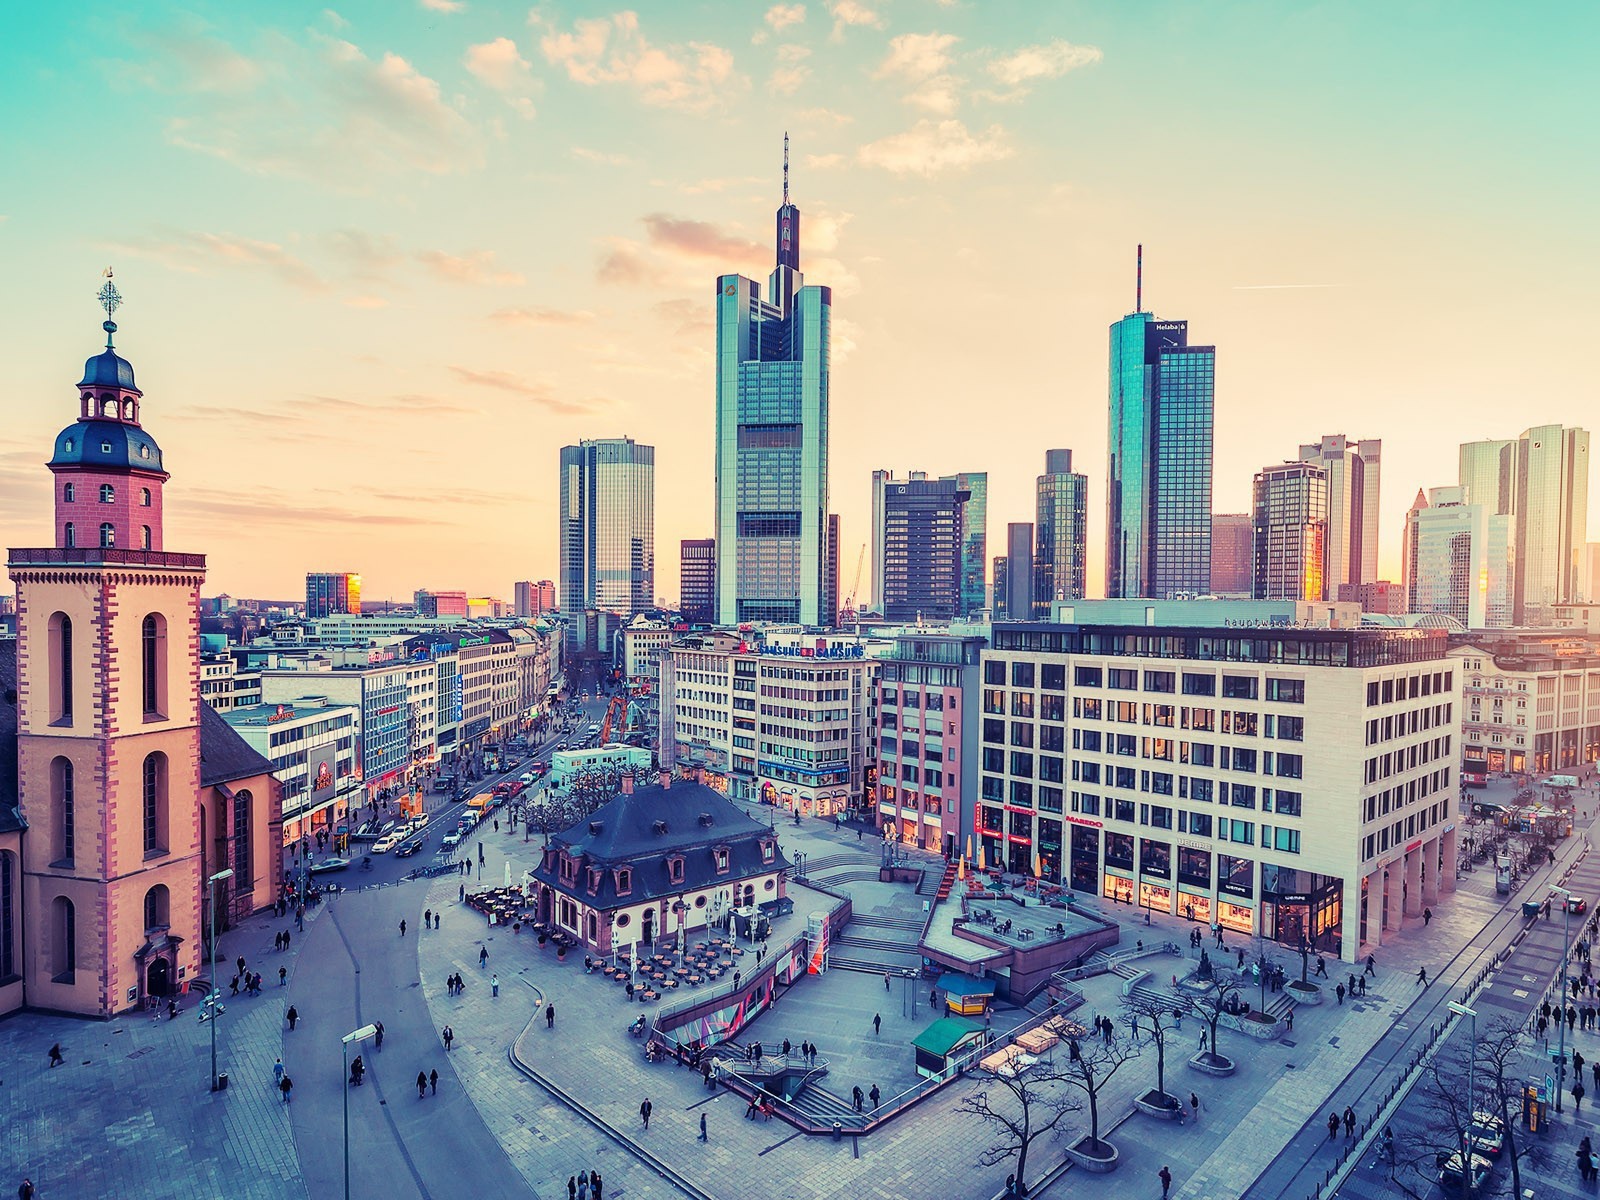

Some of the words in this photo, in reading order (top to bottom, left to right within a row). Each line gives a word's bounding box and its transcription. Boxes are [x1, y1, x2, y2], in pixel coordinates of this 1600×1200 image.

[759, 642, 800, 657] SAMSUNG
[816, 645, 864, 658] SAMSUNG
[1003, 804, 1037, 816] MAREDO
[1065, 816, 1103, 828] MAREDO
[1225, 885, 1246, 893] WEMPE
